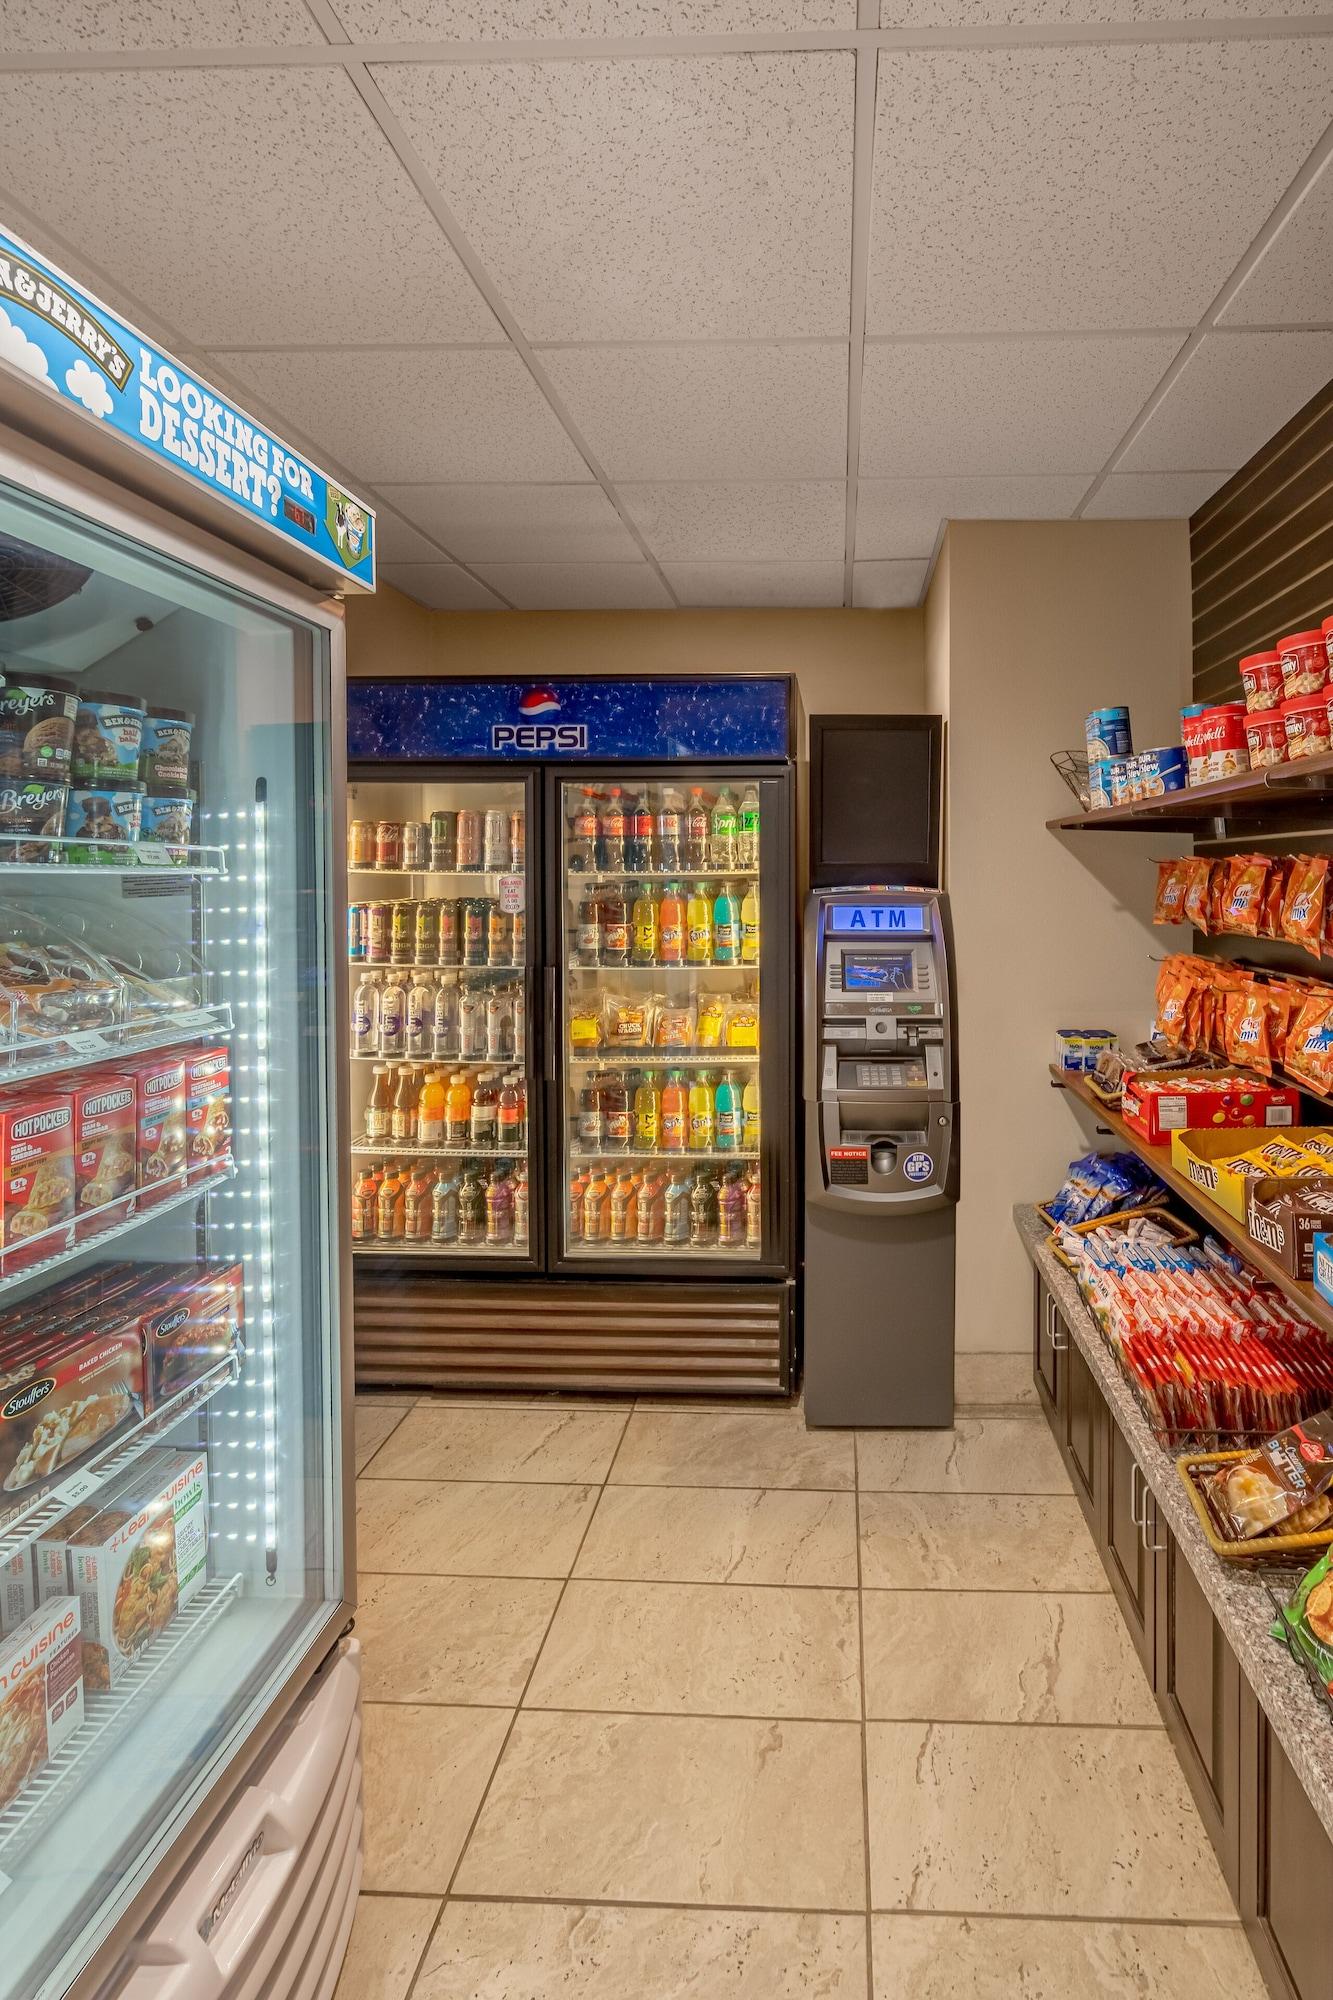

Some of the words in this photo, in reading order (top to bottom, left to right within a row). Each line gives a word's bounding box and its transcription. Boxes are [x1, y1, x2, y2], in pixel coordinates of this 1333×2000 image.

[139, 347, 269, 467] LOOKING
[272, 446, 314, 501] FOR
[139, 390, 282, 517] DESSERT?
[493, 726, 587, 749] PEPSI
[851, 910, 906, 928] ATM
[14, 1120, 34, 1138] HOT
[32, 1109, 70, 1134] POCKETS
[907, 1161, 930, 1172] GPS
[1298, 1217, 1311, 1231] 36
[99, 1341, 123, 1360] CHICKEN
[9, 1382, 51, 1416] Stouffer's
[10, 1611, 74, 1681] cuisine
